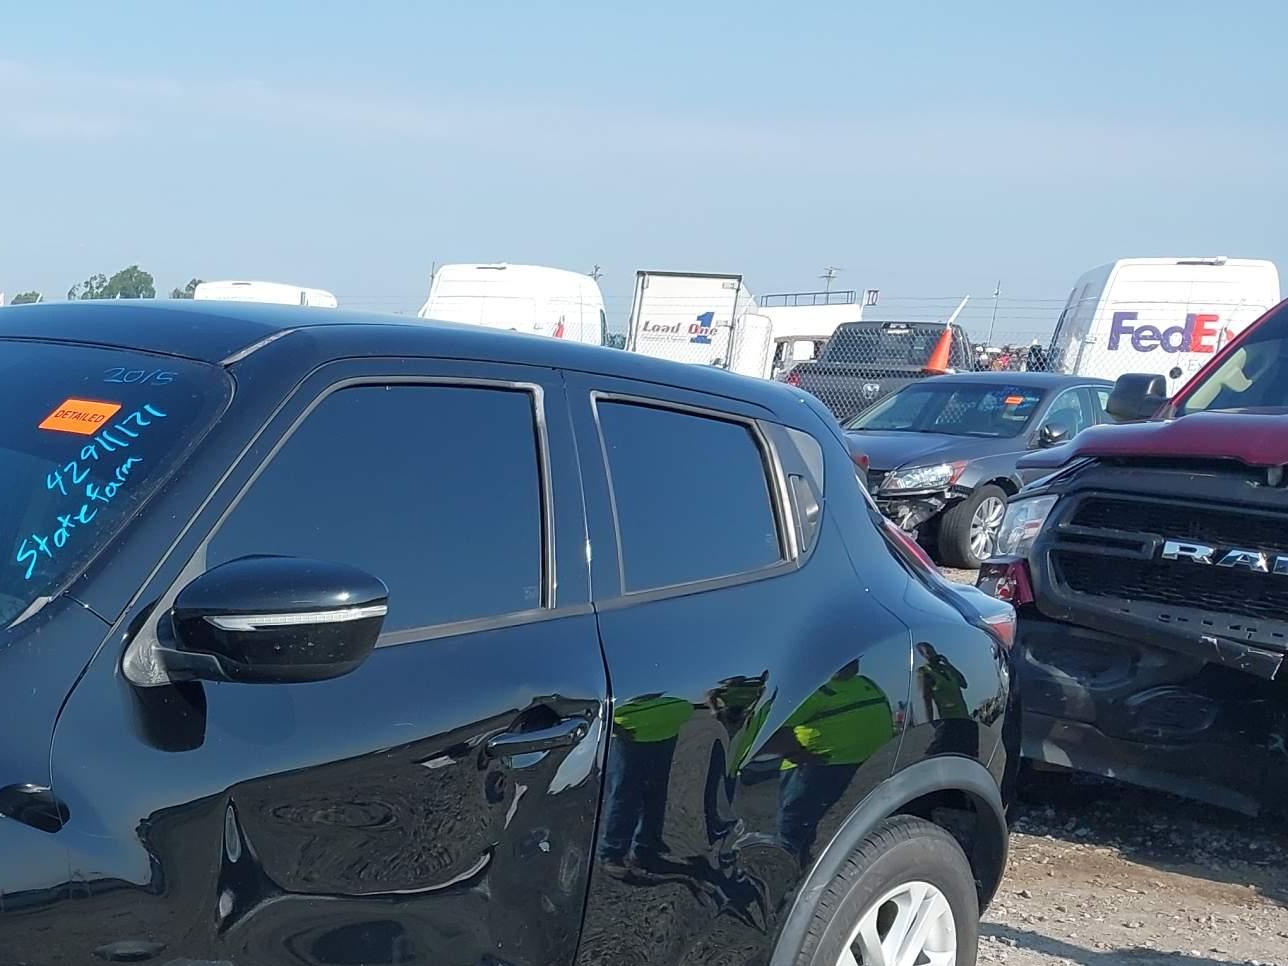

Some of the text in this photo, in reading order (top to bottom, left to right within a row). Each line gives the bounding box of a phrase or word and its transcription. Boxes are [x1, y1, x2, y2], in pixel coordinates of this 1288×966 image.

[642, 321, 718, 336] Load One
[103, 367, 178, 386] 2015
[54, 408, 106, 424] DETAILED
[46, 404, 167, 495] 42911171
